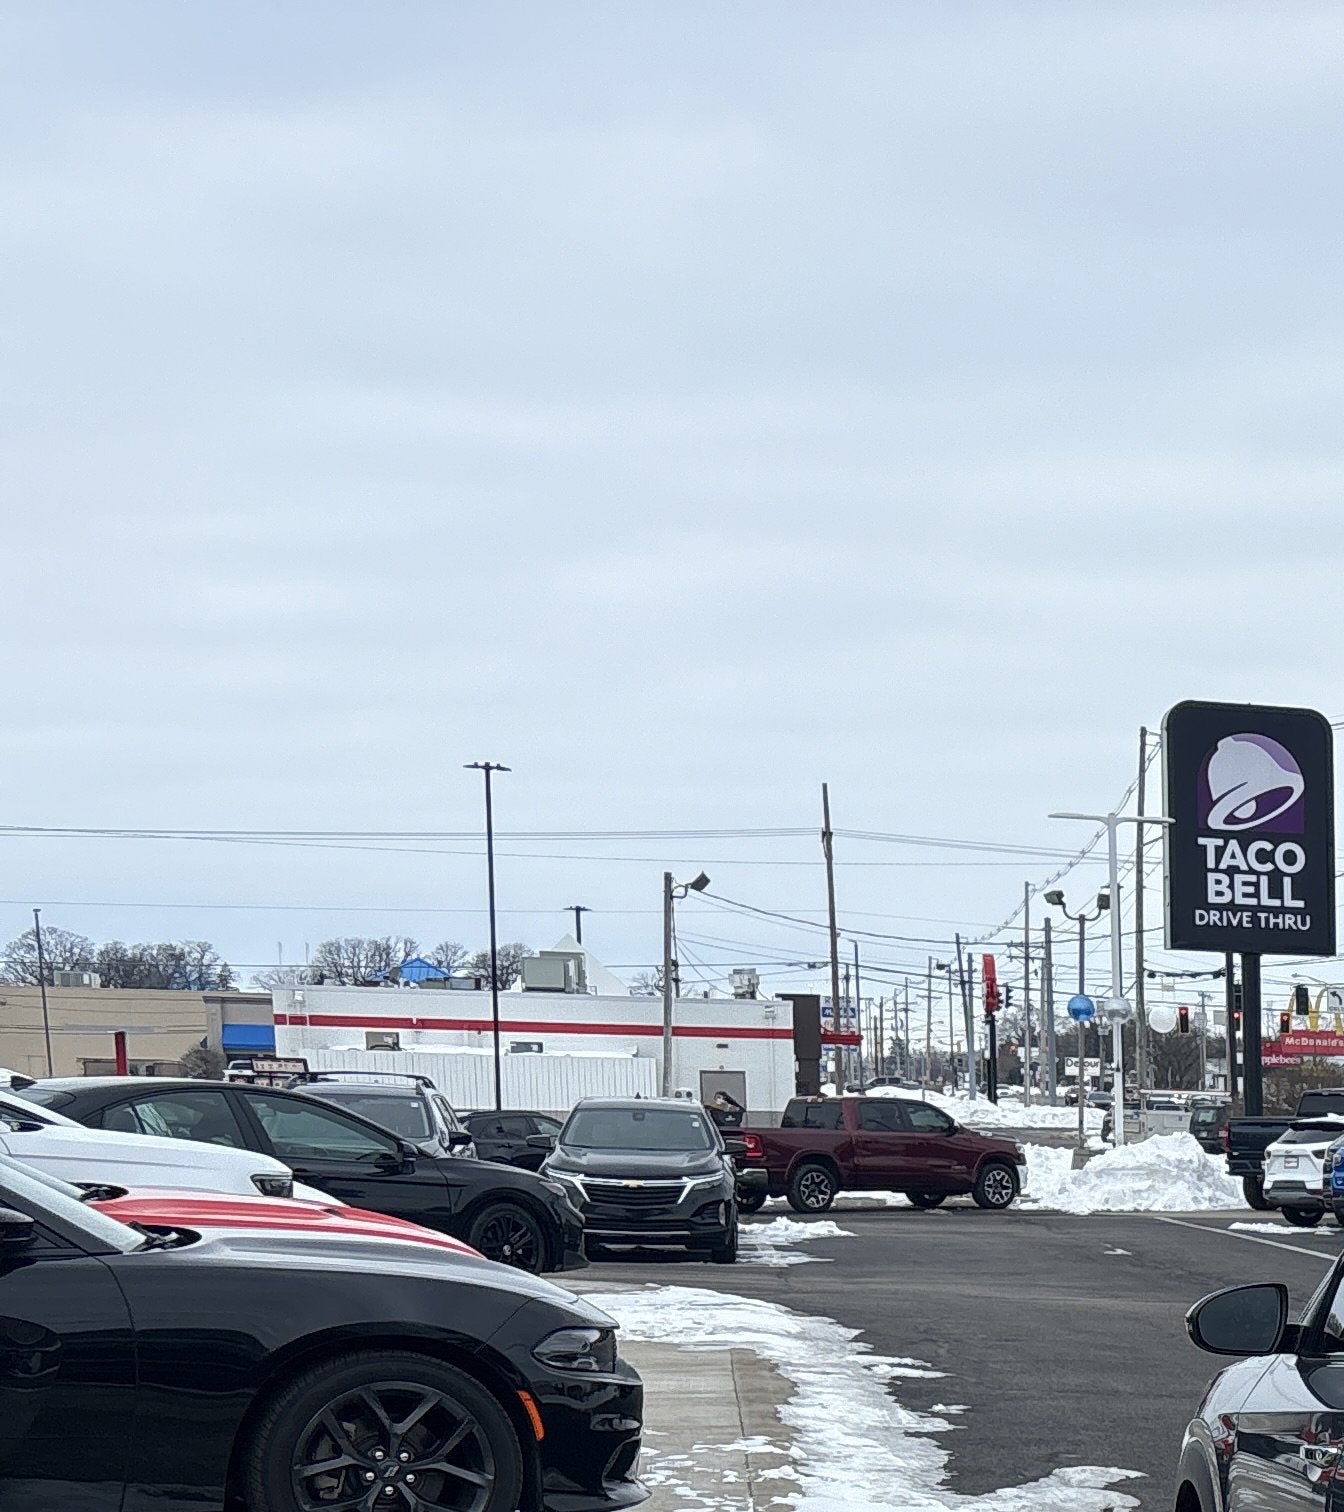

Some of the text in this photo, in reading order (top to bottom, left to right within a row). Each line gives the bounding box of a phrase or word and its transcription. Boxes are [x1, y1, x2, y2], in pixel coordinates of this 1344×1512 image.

[1197, 836, 1306, 874] TACO
[1206, 872, 1305, 909] BELL
[1194, 909, 1311, 931] DRIVE THRU
[1065, 1058, 1100, 1068] Deour
